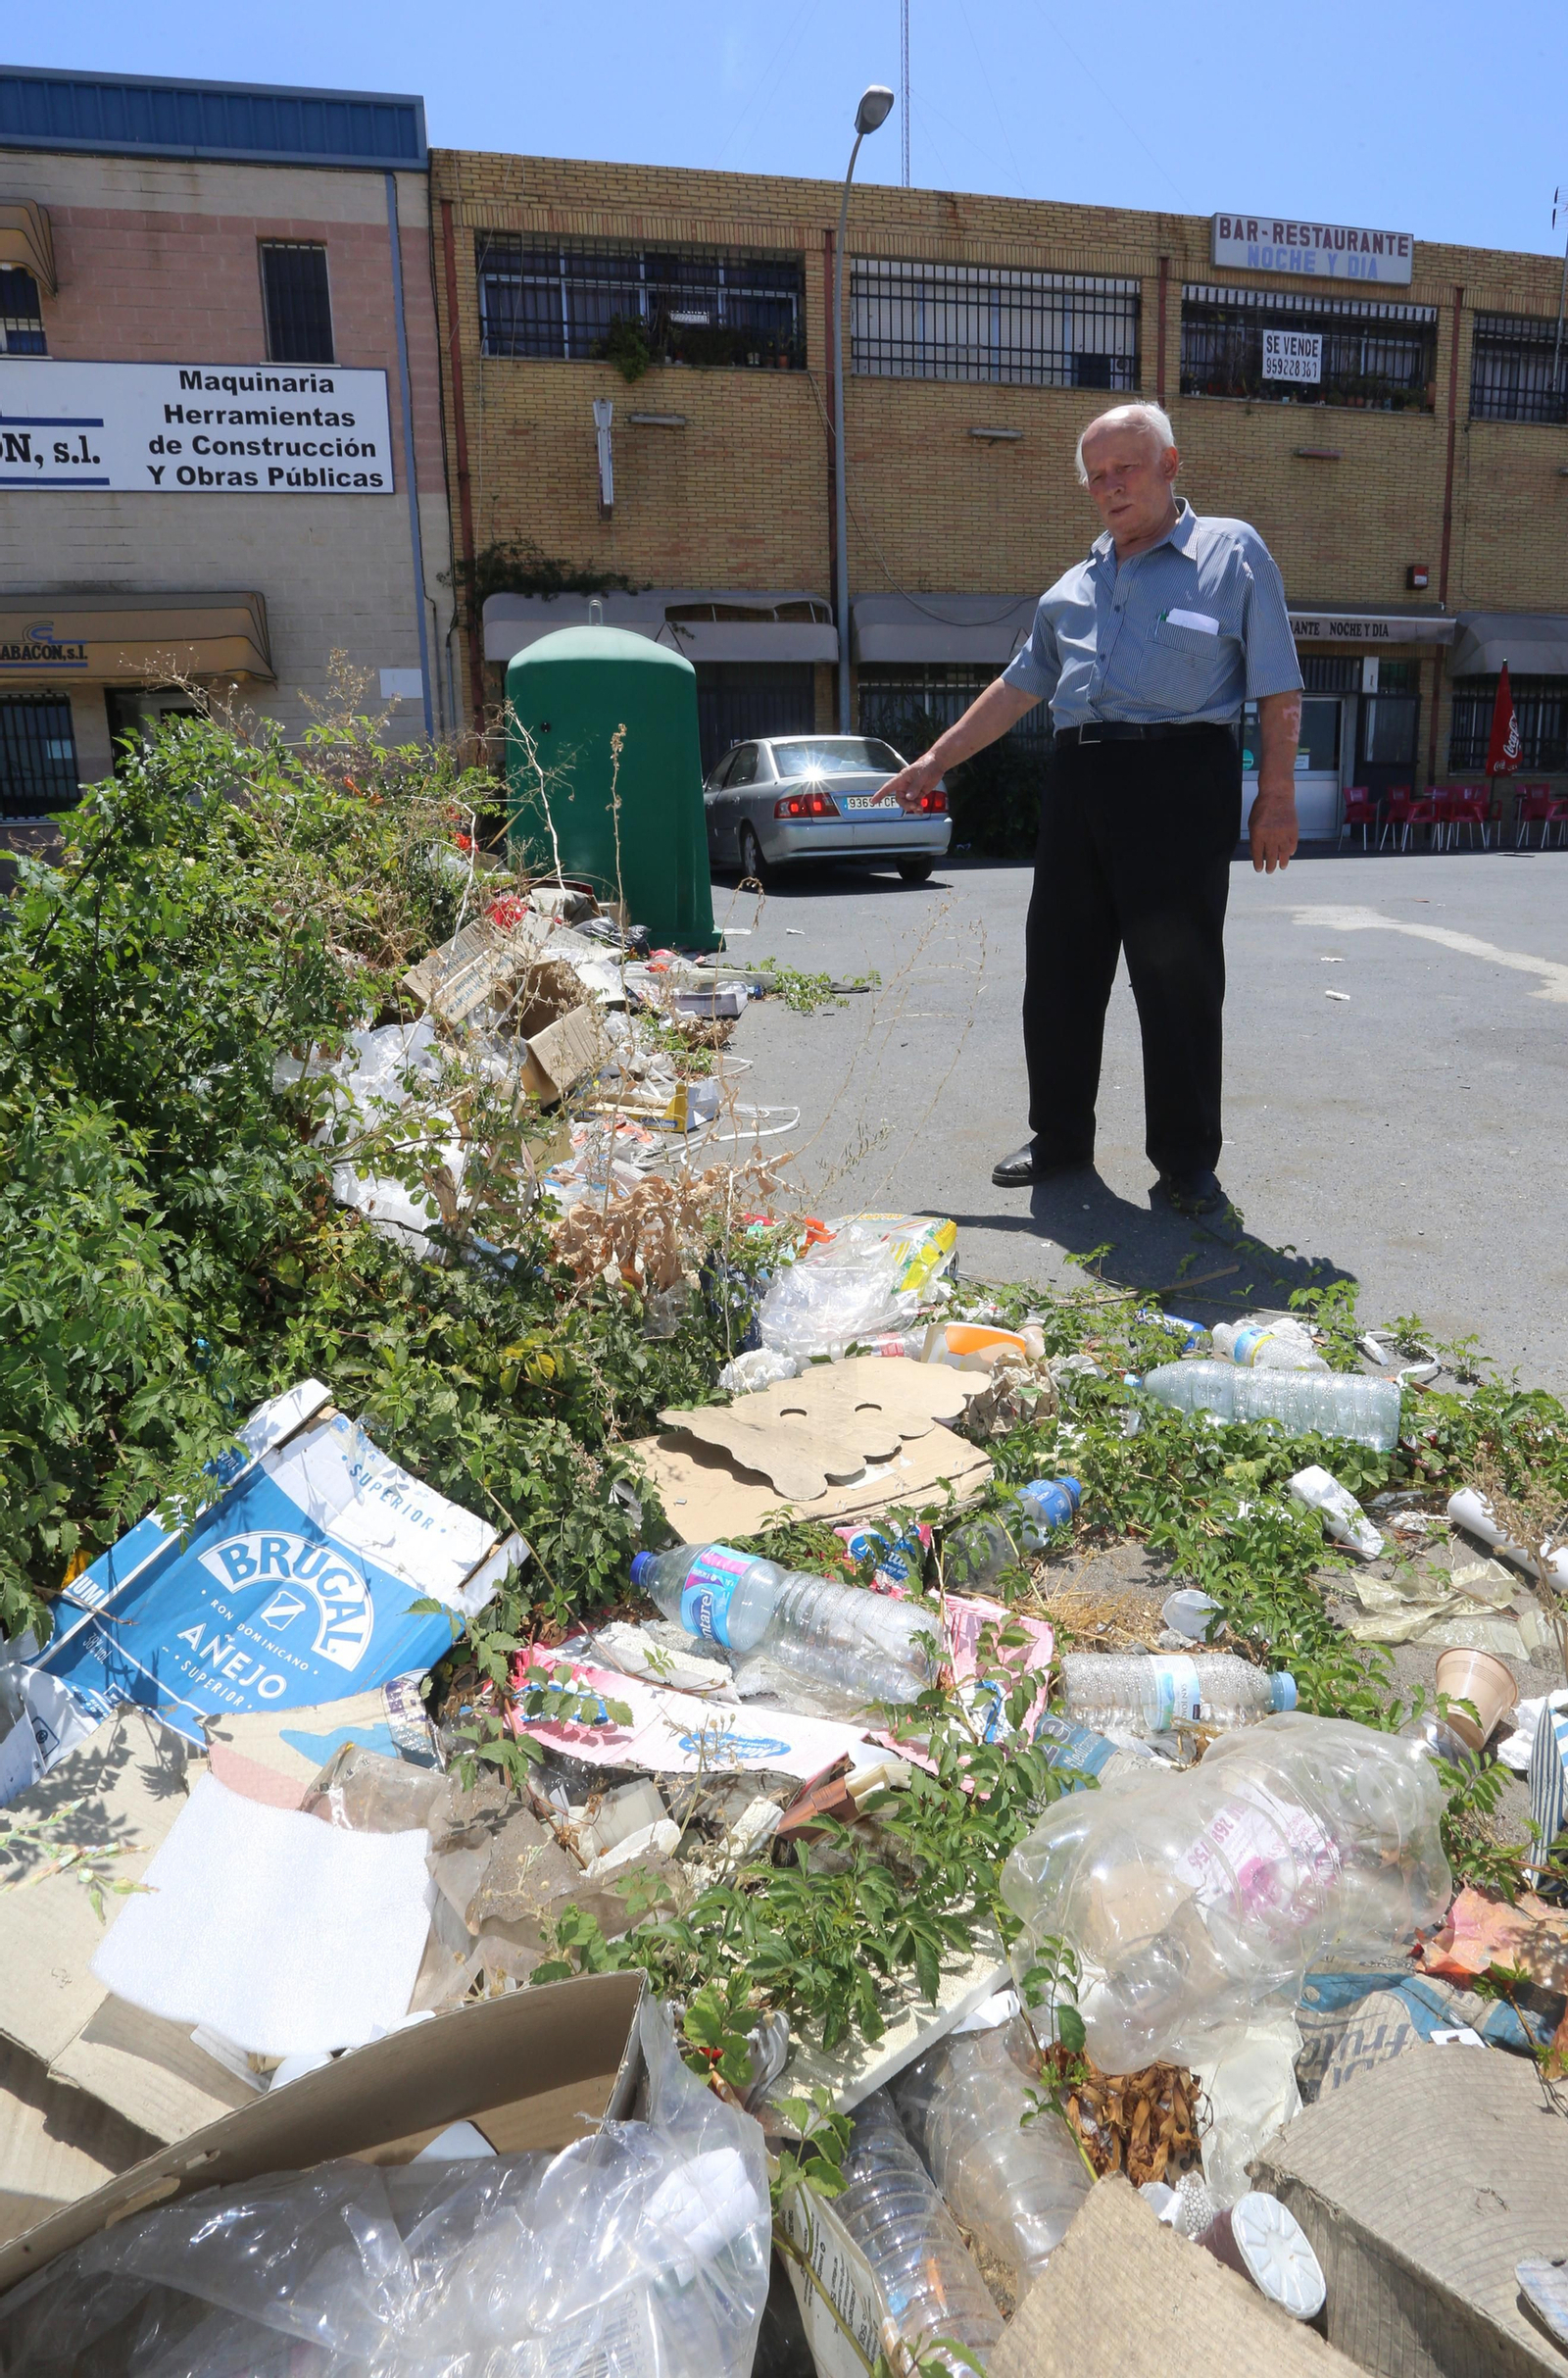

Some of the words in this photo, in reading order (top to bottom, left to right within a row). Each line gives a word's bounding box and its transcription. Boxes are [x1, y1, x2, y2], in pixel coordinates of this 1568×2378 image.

[1247, 244, 1316, 273] NOCHE
[1327, 252, 1339, 275] Y
[1348, 255, 1379, 279] DIA
[1266, 334, 1280, 354] SE
[1283, 336, 1319, 358] VENDE
[178, 370, 335, 395] Maquinaria
[164, 404, 356, 427] Herramientas
[0, 432, 44, 471] N,
[148, 435, 182, 456] de
[191, 435, 377, 458] Construcción
[146, 465, 166, 485] Y
[175, 466, 259, 487] Obras
[268, 466, 384, 488] Públicas
[1329, 621, 1362, 637] NOCHE
[1361, 623, 1370, 637] Y
[1372, 623, 1390, 637] DIA
[349, 1463, 435, 1530] SUPERIOR
[216, 1536, 367, 1652] BRUGAL
[210, 1599, 234, 1621] RON
[236, 1622, 310, 1672] DOMINICANO
[176, 1622, 288, 1700] AÑEJO
[180, 1660, 245, 1708] SUPERIOR
